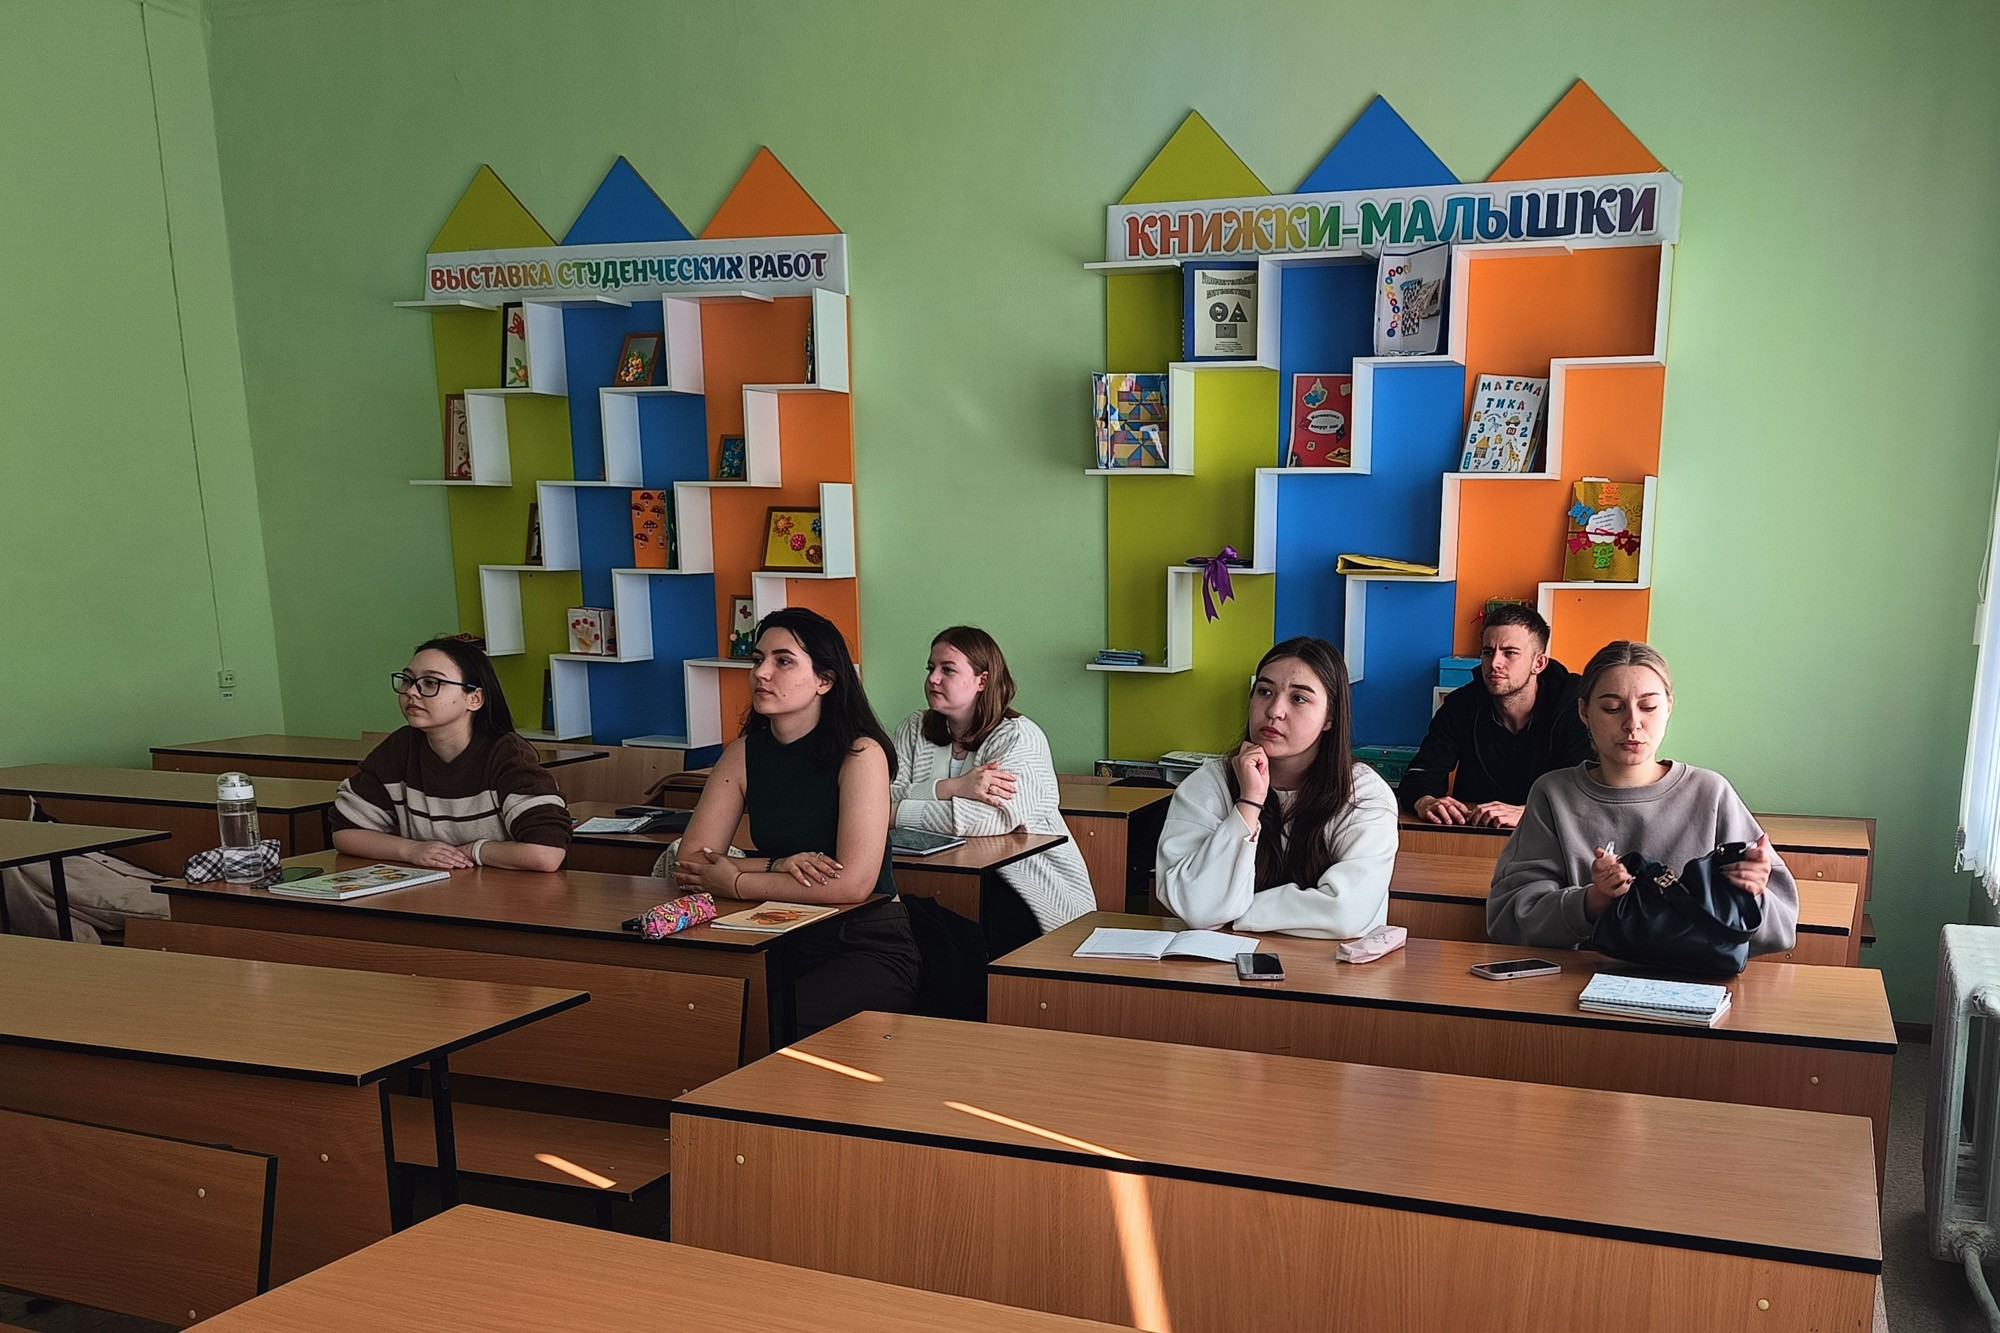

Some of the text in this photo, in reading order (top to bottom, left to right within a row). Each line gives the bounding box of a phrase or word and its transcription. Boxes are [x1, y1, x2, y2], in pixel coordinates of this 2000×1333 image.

[1125, 186, 1660, 258] КНИЖКИ-МАЛЫШКИ
[431, 253, 827, 291] ВЫСТАВКА СТУДЕНЧЕСКИХ РАБОТ
[1481, 380, 1542, 396] МАТЕМА
[1486, 398, 1526, 410] ТИКА
[1477, 423, 1485, 433] 3
[1519, 426, 1528, 437] 2
[1491, 459, 1500, 469] 9
